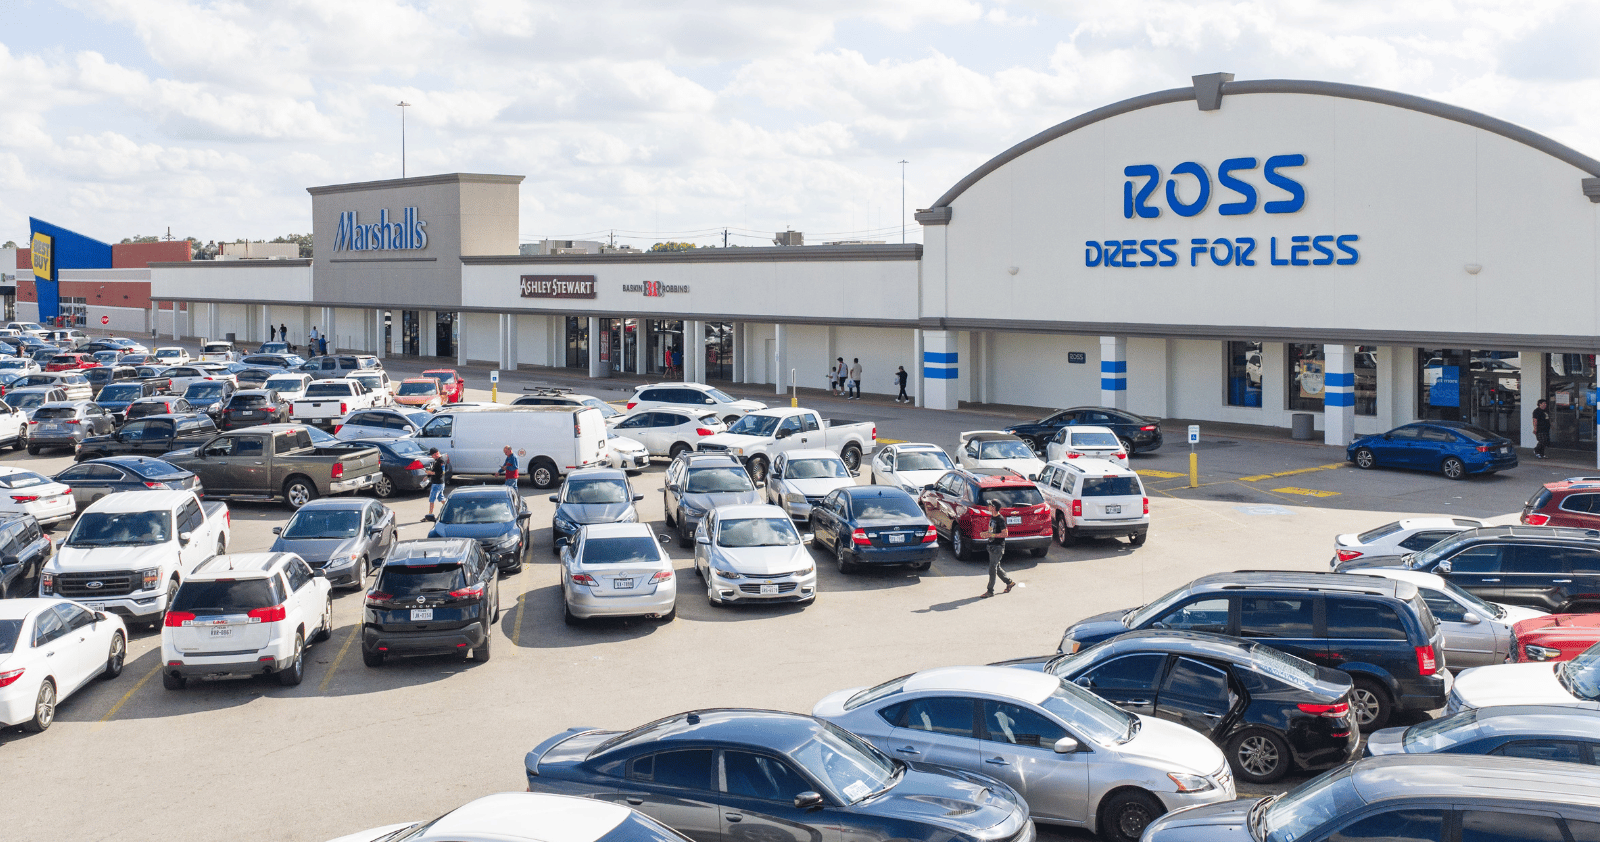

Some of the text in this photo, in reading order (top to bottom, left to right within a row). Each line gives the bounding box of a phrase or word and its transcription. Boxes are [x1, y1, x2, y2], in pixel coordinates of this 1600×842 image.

[1124, 153, 1307, 219] ROSS
[333, 207, 426, 252] Marshalls
[34, 239, 50, 257] BEST
[1085, 234, 1360, 268] DRESS FOR LESS
[34, 254, 49, 271] BUY
[520, 278, 592, 296] ASHLEY STEWART
[622, 284, 643, 293] BASKIN
[662, 284, 689, 293] ROBBINS
